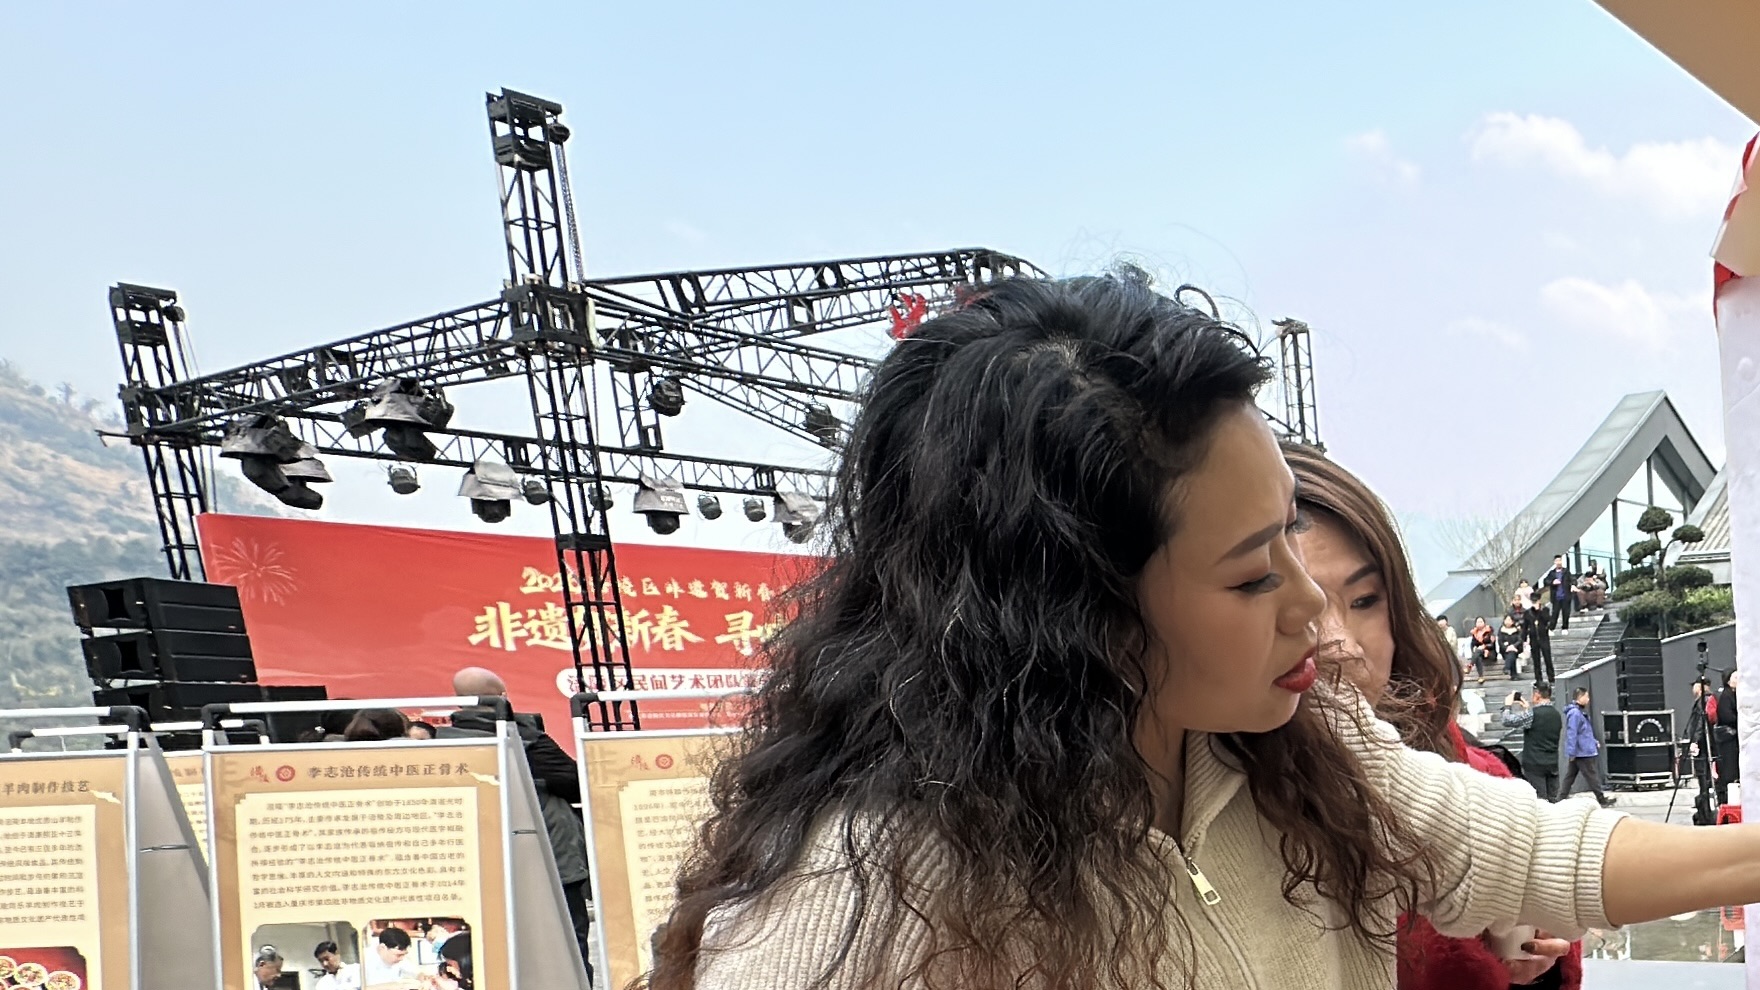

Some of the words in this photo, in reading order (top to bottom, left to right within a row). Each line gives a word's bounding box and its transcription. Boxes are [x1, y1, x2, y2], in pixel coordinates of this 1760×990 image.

[2, 780, 90, 795] 羊肉制作技艺
